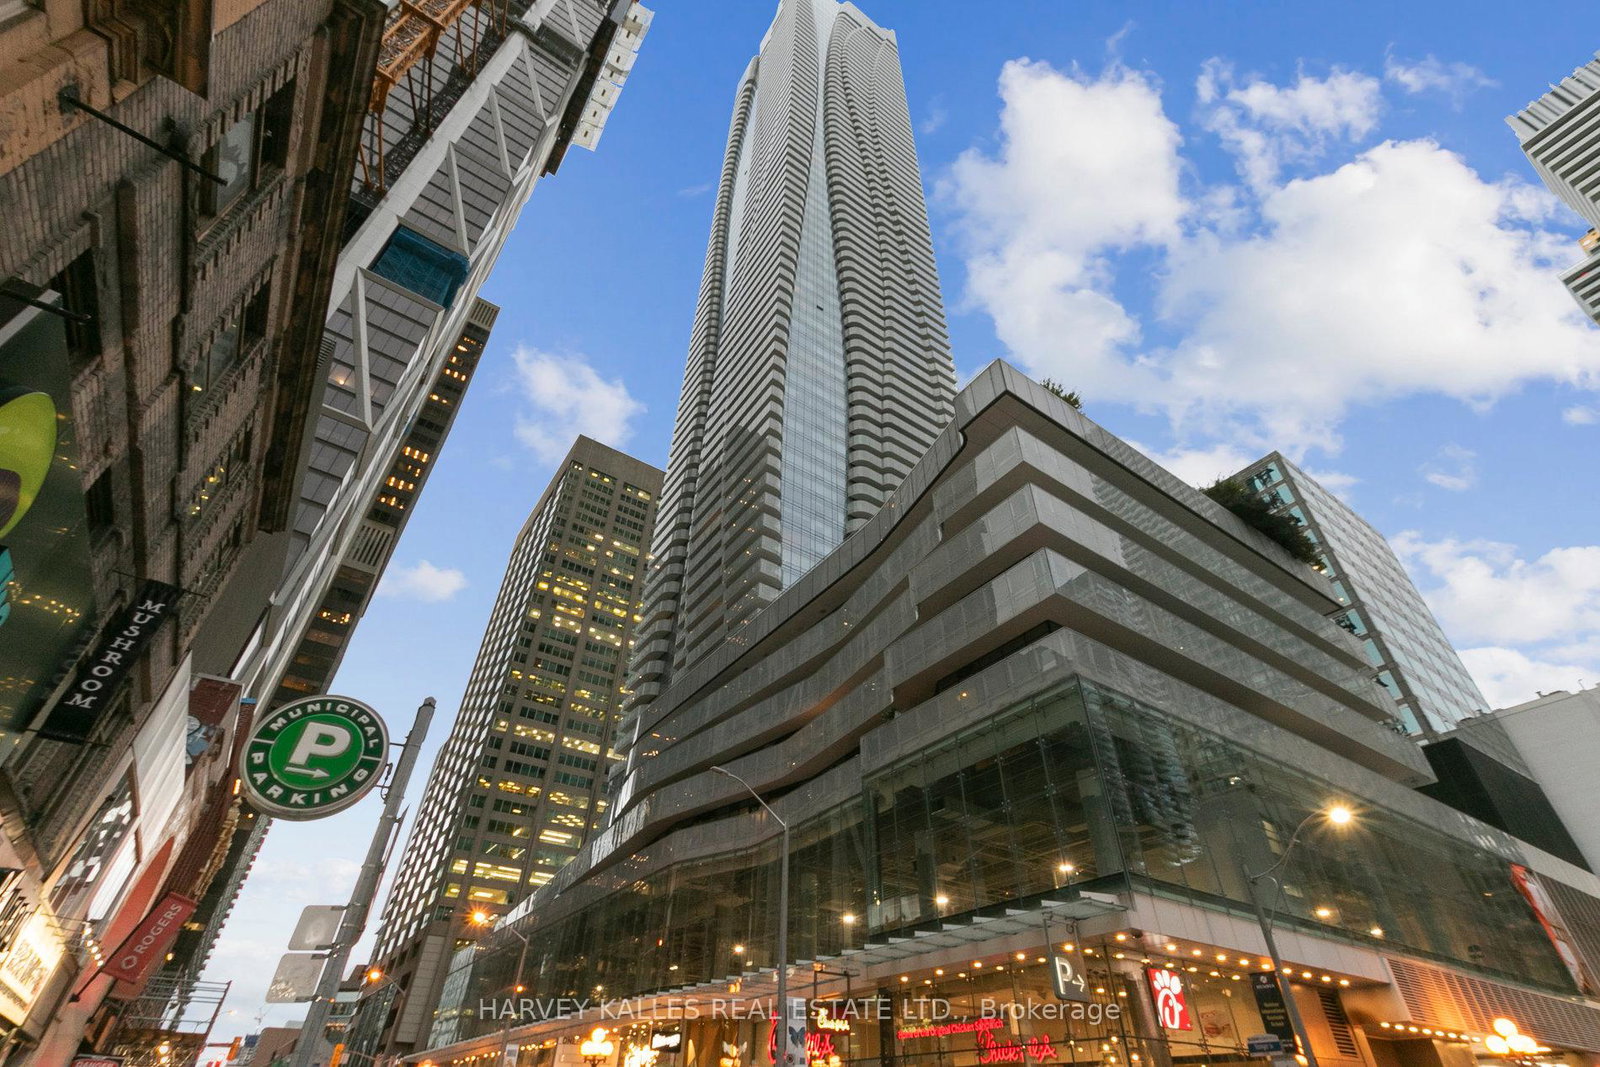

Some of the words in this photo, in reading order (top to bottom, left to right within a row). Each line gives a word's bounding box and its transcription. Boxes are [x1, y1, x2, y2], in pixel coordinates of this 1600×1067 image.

[64, 600, 166, 709] MUSHROOM
[269, 702, 380, 748] MUNICIPAL
[288, 721, 351, 765] P
[251, 752, 369, 805] PARKING
[134, 903, 183, 954] ROGERS
[1055, 956, 1073, 995] P
